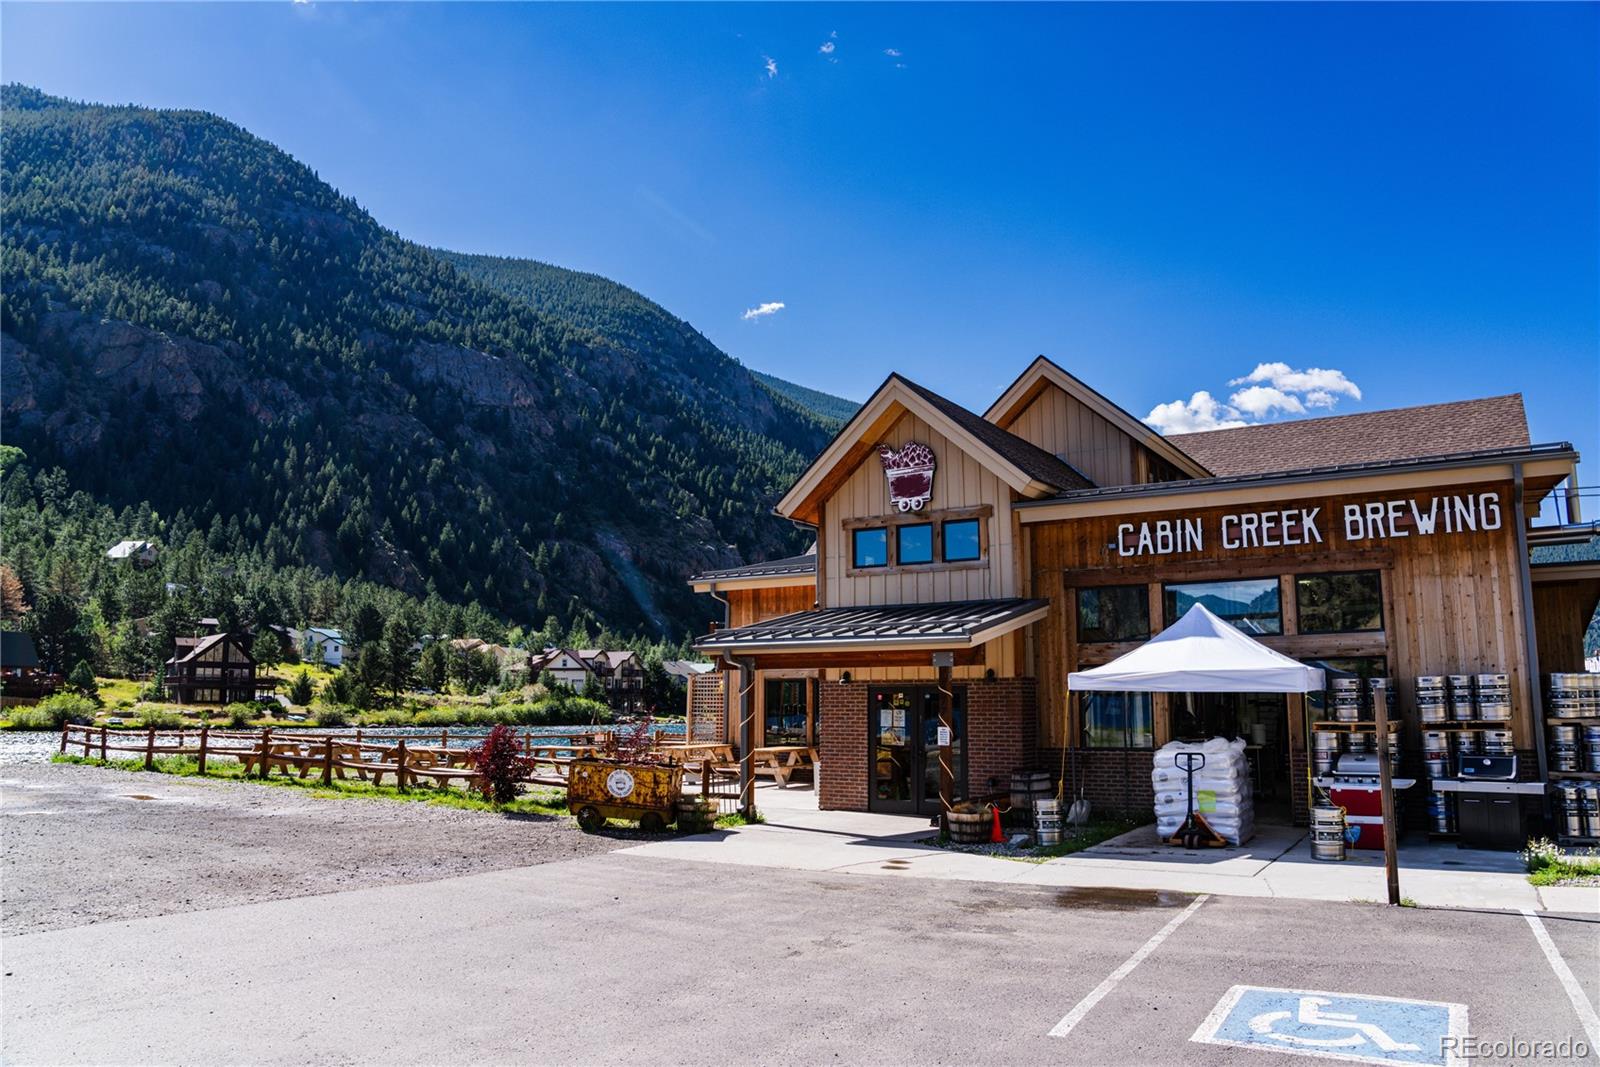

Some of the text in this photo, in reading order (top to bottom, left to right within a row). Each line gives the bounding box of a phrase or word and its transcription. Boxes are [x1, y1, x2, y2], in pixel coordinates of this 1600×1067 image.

[1117, 492, 1501, 557] CABIN CREEK BREWING
